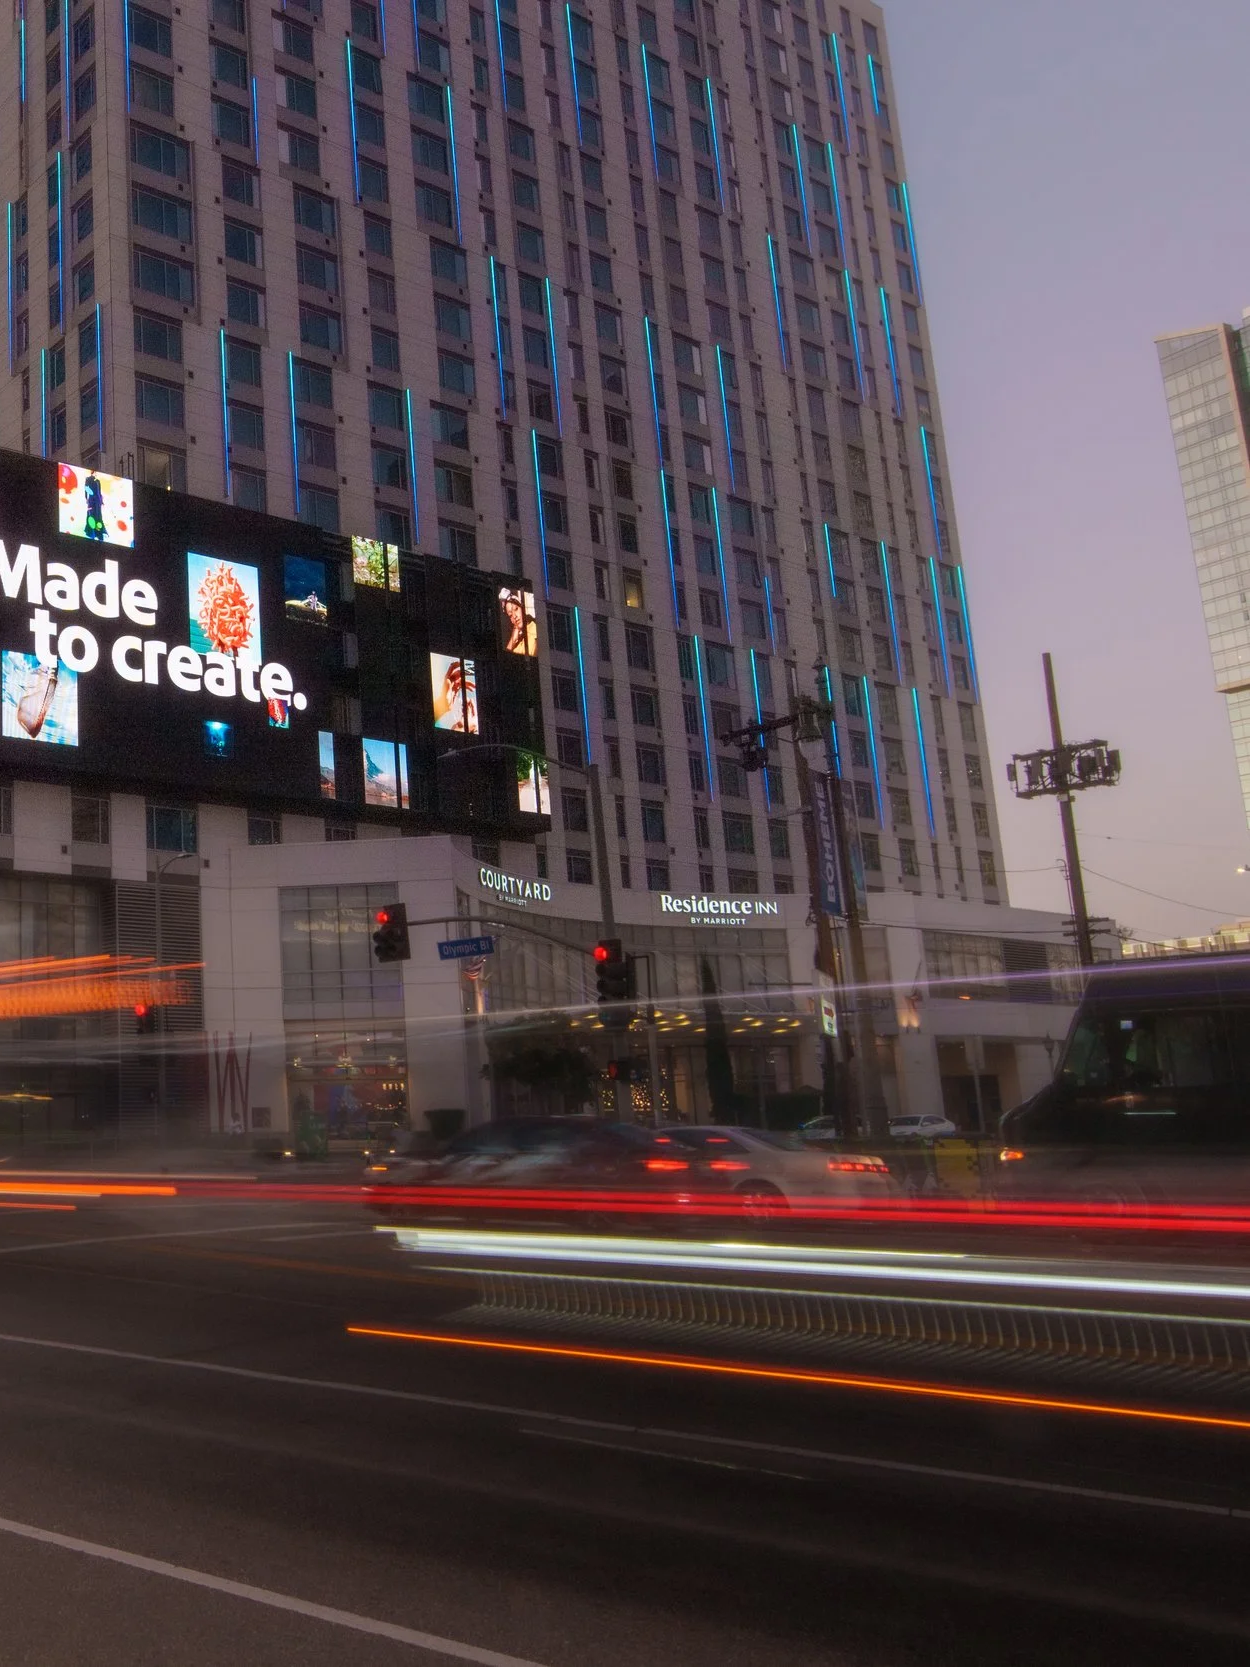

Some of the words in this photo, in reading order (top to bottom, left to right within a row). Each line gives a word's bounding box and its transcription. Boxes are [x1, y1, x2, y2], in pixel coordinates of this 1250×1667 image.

[30, 608, 99, 673] to
[111, 635, 308, 711] create.
[480, 868, 551, 901] COURTYARD
[661, 894, 752, 914] Residence
[755, 901, 778, 915] INN
[703, 917, 746, 925] MARRIOTT
[443, 944, 477, 955] Olympic
